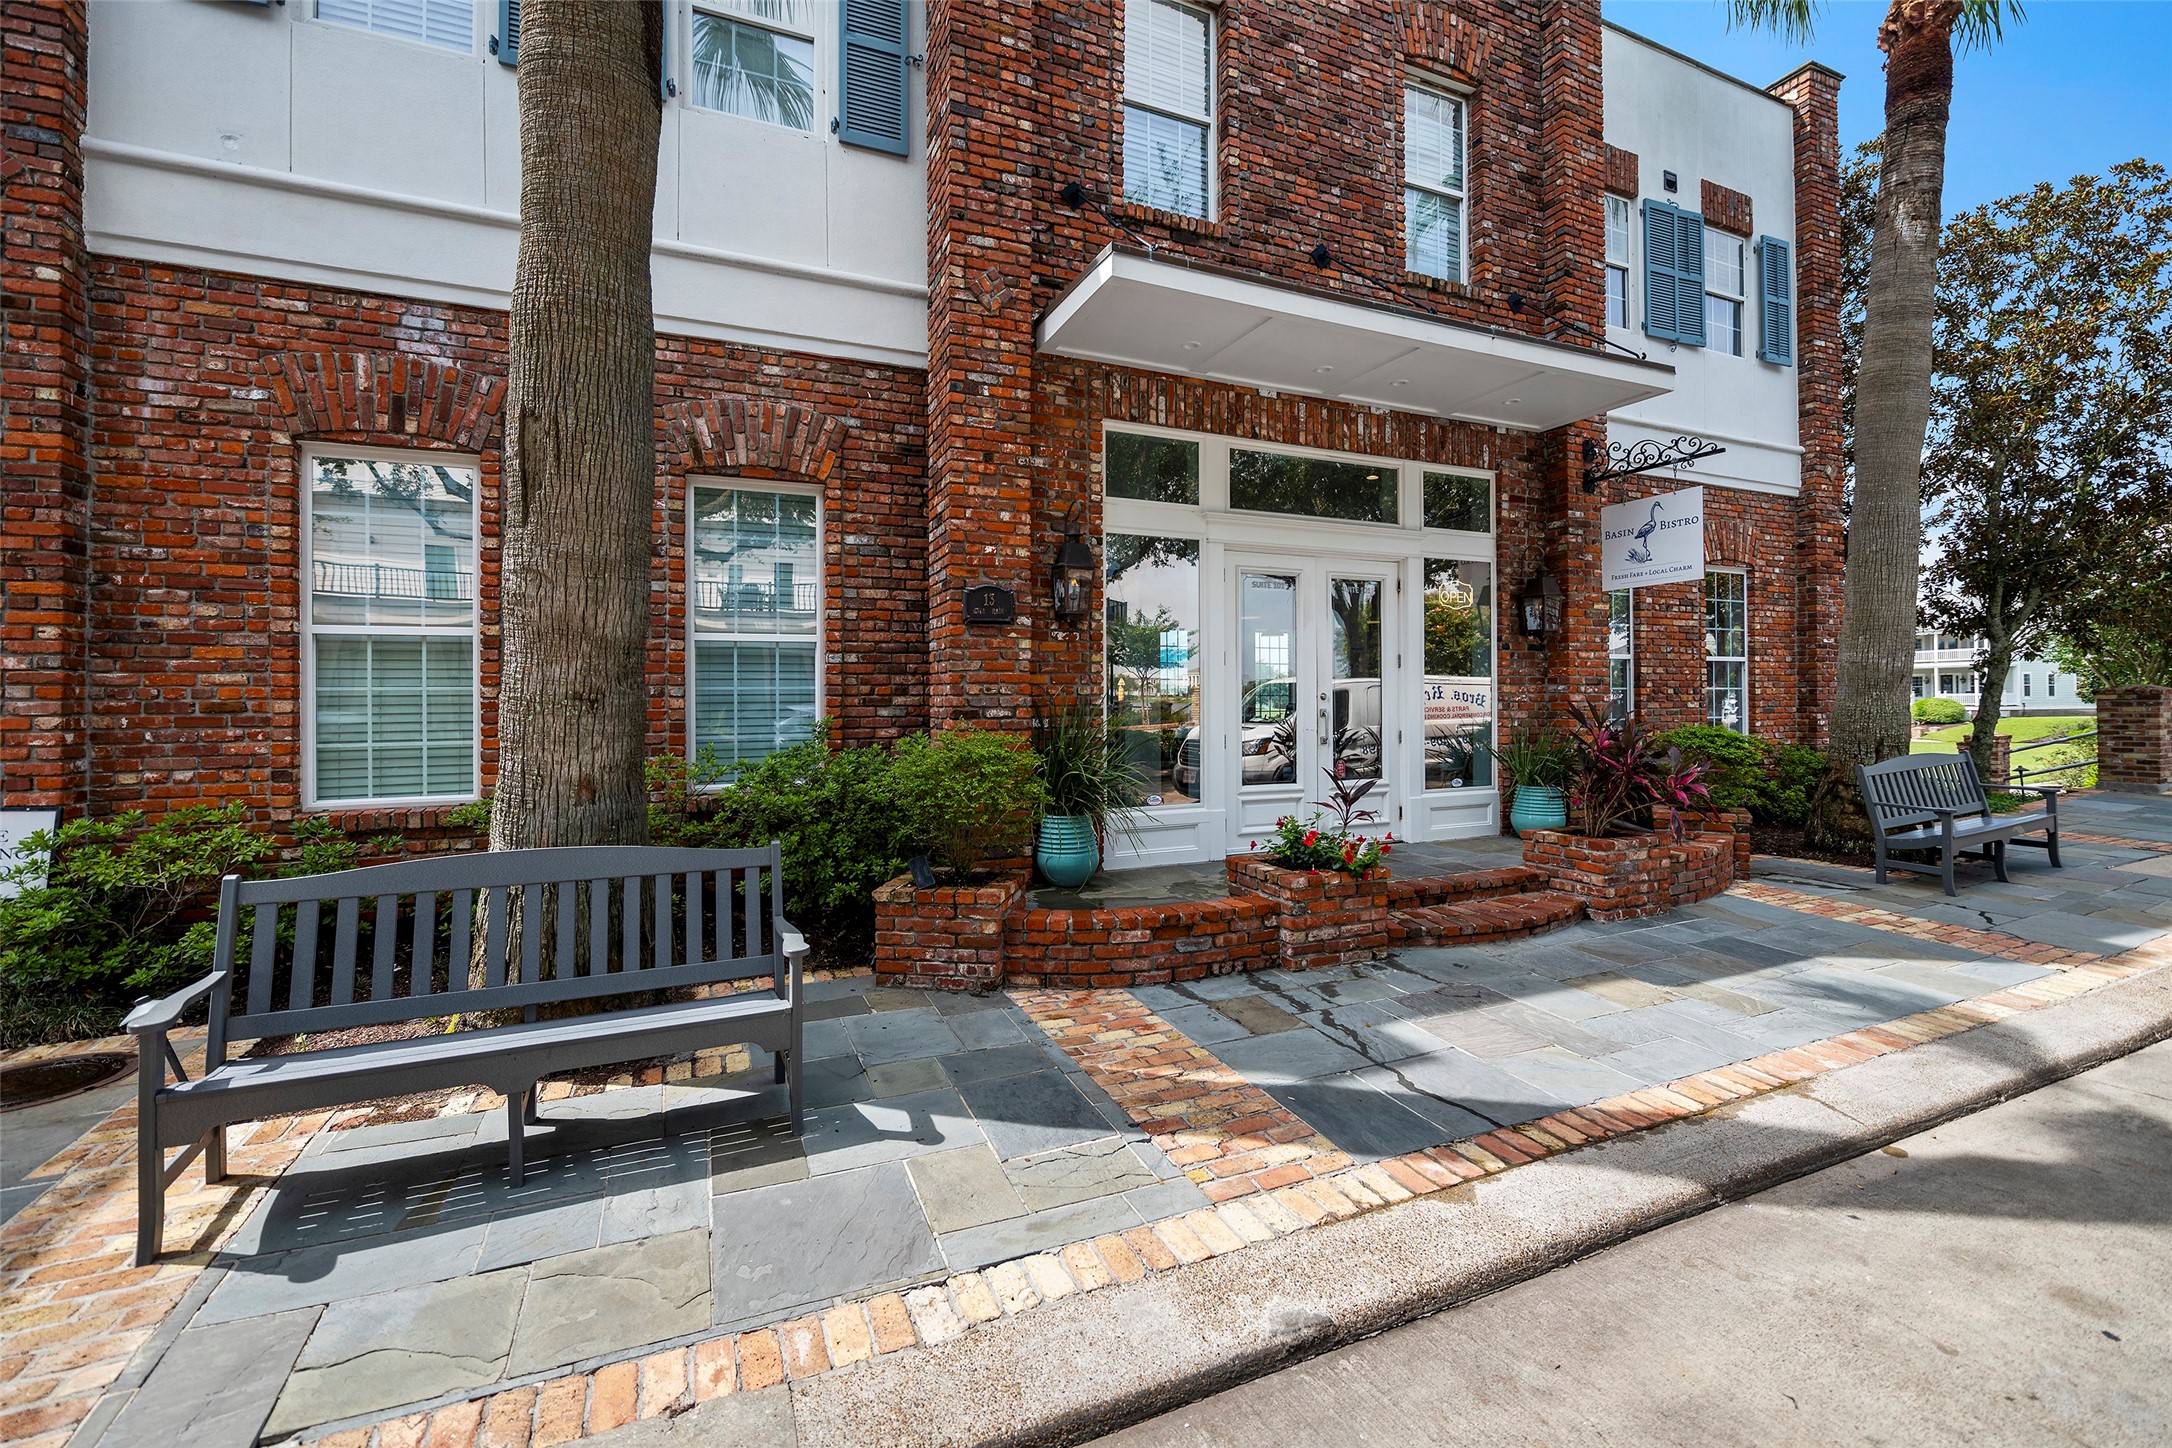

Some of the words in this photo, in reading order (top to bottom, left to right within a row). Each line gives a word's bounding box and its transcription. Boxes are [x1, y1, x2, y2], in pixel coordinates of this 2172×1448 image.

[1604, 528, 1635, 541] BASIN
[1659, 515, 1699, 530] BISTRO
[1611, 572, 1629, 581] FRESH
[1629, 571, 1644, 579] FARE
[1649, 567, 1668, 576] LOCAL
[1668, 564, 1693, 573] CHARM
[1251, 580, 1272, 589] SUITE
[1440, 590, 1473, 604] OPEN
